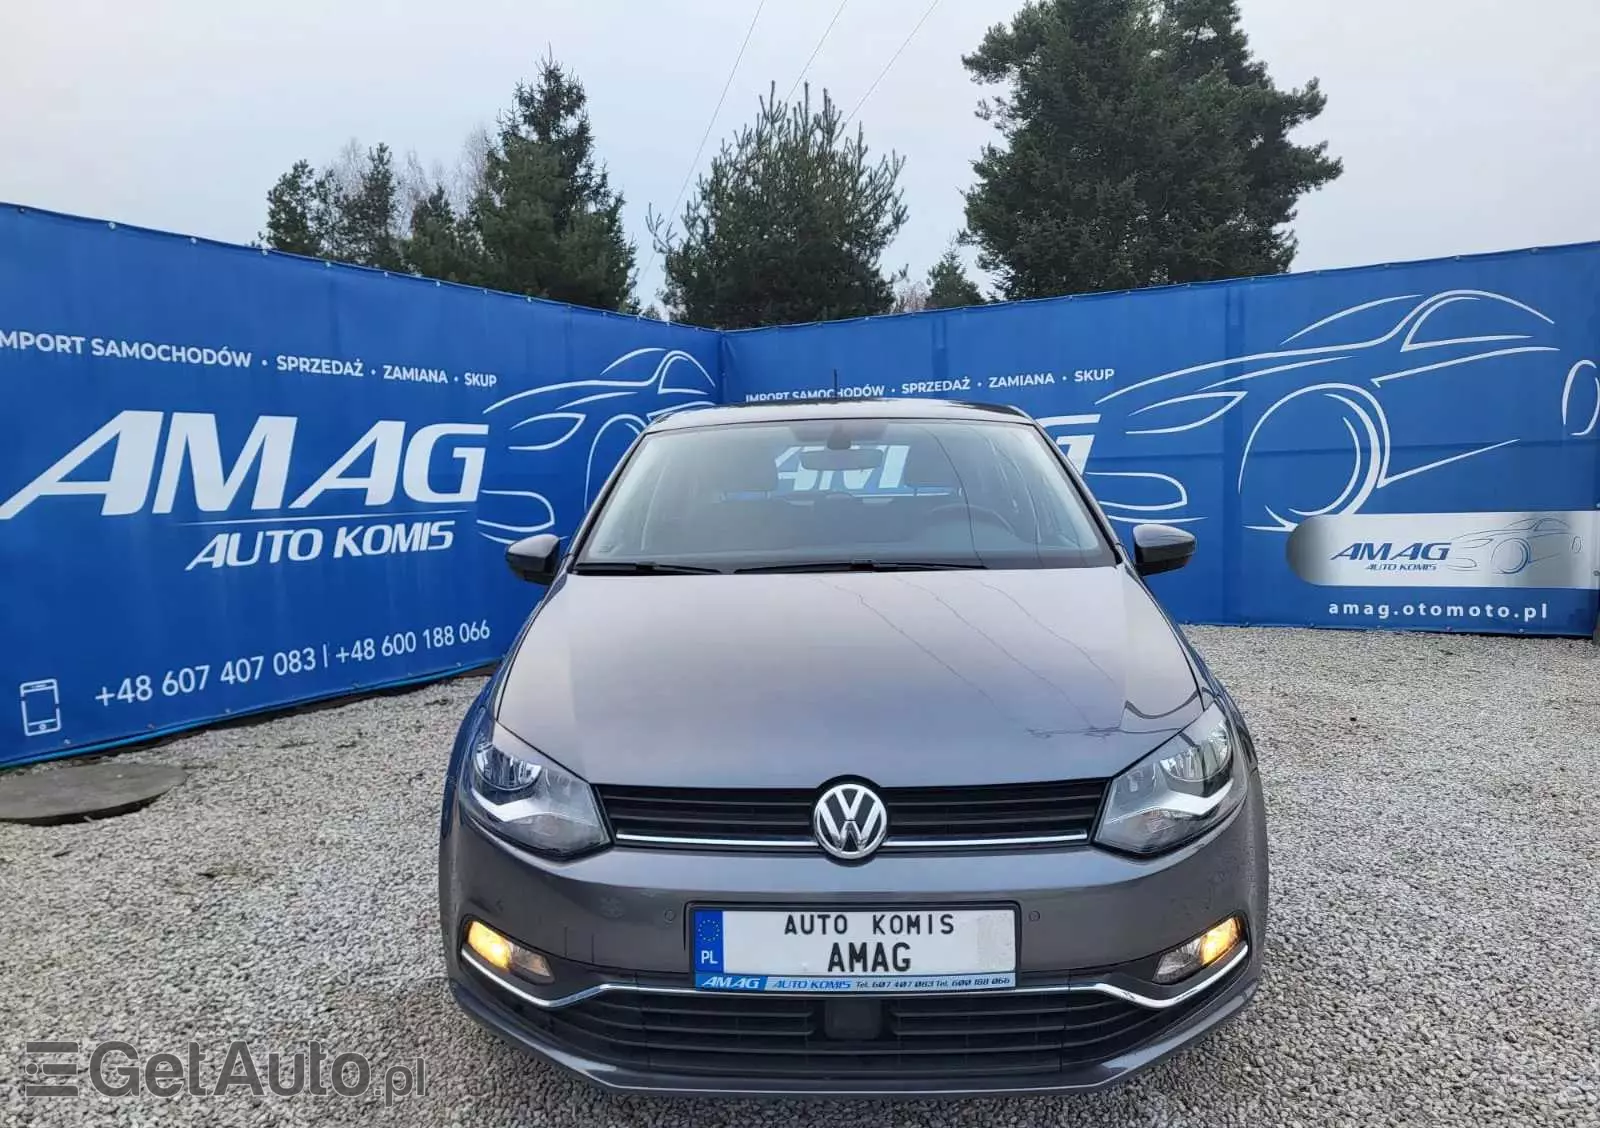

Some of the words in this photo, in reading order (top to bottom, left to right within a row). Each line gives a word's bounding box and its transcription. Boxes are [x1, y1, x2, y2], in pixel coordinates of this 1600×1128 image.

[91, 338, 252, 368] SAMOCHODÓW
[276, 355, 365, 377] SPRZEDAŻ
[383, 365, 448, 384] ZAMIANA
[464, 372, 497, 388] SKUP
[902, 376, 971, 394] SPRZEDAŻ
[988, 373, 1055, 388] ZAMIANA
[1074, 368, 1115, 382] SKUP
[185, 526, 323, 571] AUTO
[333, 520, 455, 559] KOMIS
[1328, 601, 1548, 622] amag.otomoto.pl
[95, 674, 153, 707] +48
[162, 665, 210, 696] 607
[220, 656, 264, 685] 407
[273, 648, 316, 676] 083
[335, 637, 376, 664] +48
[381, 631, 417, 657] 600
[422, 625, 455, 649] 188
[459, 619, 491, 643] 066
[784, 914, 848, 935] AUTO
[872, 914, 955, 935] KOMIS
[701, 950, 718, 964] PL
[827, 942, 911, 973] AMAG
[773, 980, 808, 989] AUTO
[811, 980, 850, 990] KOMIS
